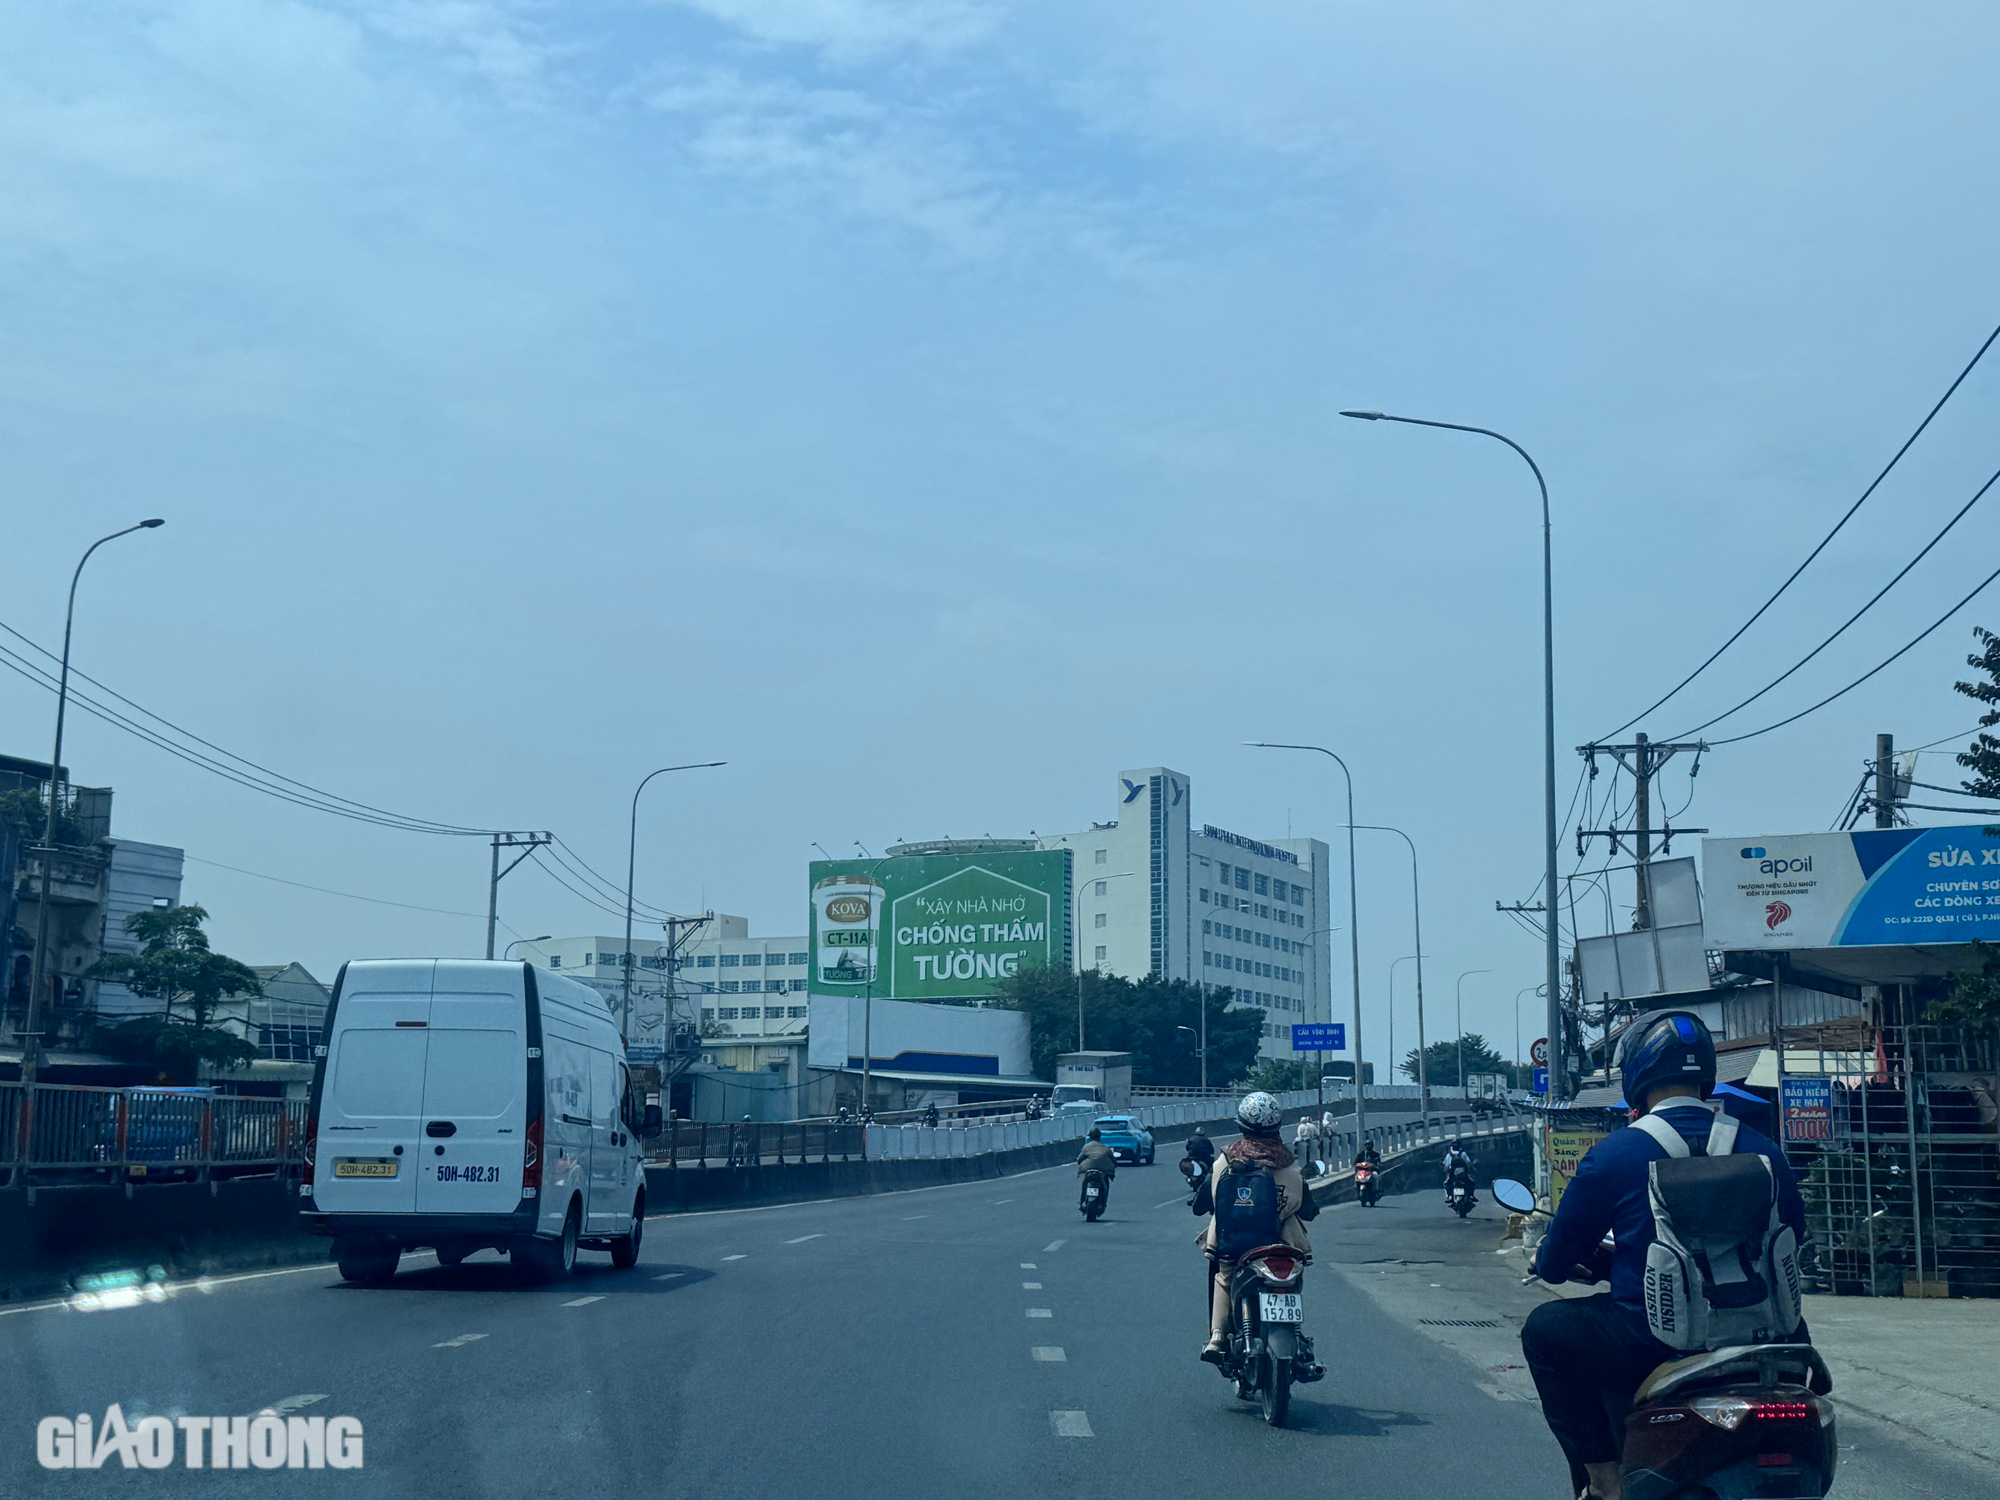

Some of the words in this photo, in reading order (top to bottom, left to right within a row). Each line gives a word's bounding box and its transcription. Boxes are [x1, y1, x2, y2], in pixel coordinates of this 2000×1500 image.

[1928, 844, 1976, 868] SỬA
[1760, 855, 1813, 879] apoil
[1926, 878, 1979, 892] CHUYÊN
[956, 896, 989, 914] NHÀ
[991, 893, 1026, 913] NHỚ
[1914, 894, 1941, 908] CÁC
[1944, 894, 1982, 907] DÒNG
[831, 902, 866, 915] KOVA
[1912, 914, 1934, 923] 222D
[896, 917, 977, 946] CHỐNG
[979, 914, 1045, 943] THẤM
[827, 931, 869, 945] CT-11A
[1784, 1086, 1803, 1097] BẢO
[1805, 1086, 1829, 1097] HIỂM
[1790, 1098, 1802, 1107] XE
[1790, 1107, 1799, 1118] 2
[1785, 1119, 1831, 1140] 100K
[436, 1165, 500, 1183] 50H-482.31
[1645, 1265, 1660, 1331] FASHION
[1659, 1272, 1676, 1334] INSIDER
[1263, 1308, 1302, 1321] 152.89
[1649, 1413, 1685, 1424] LEAD
